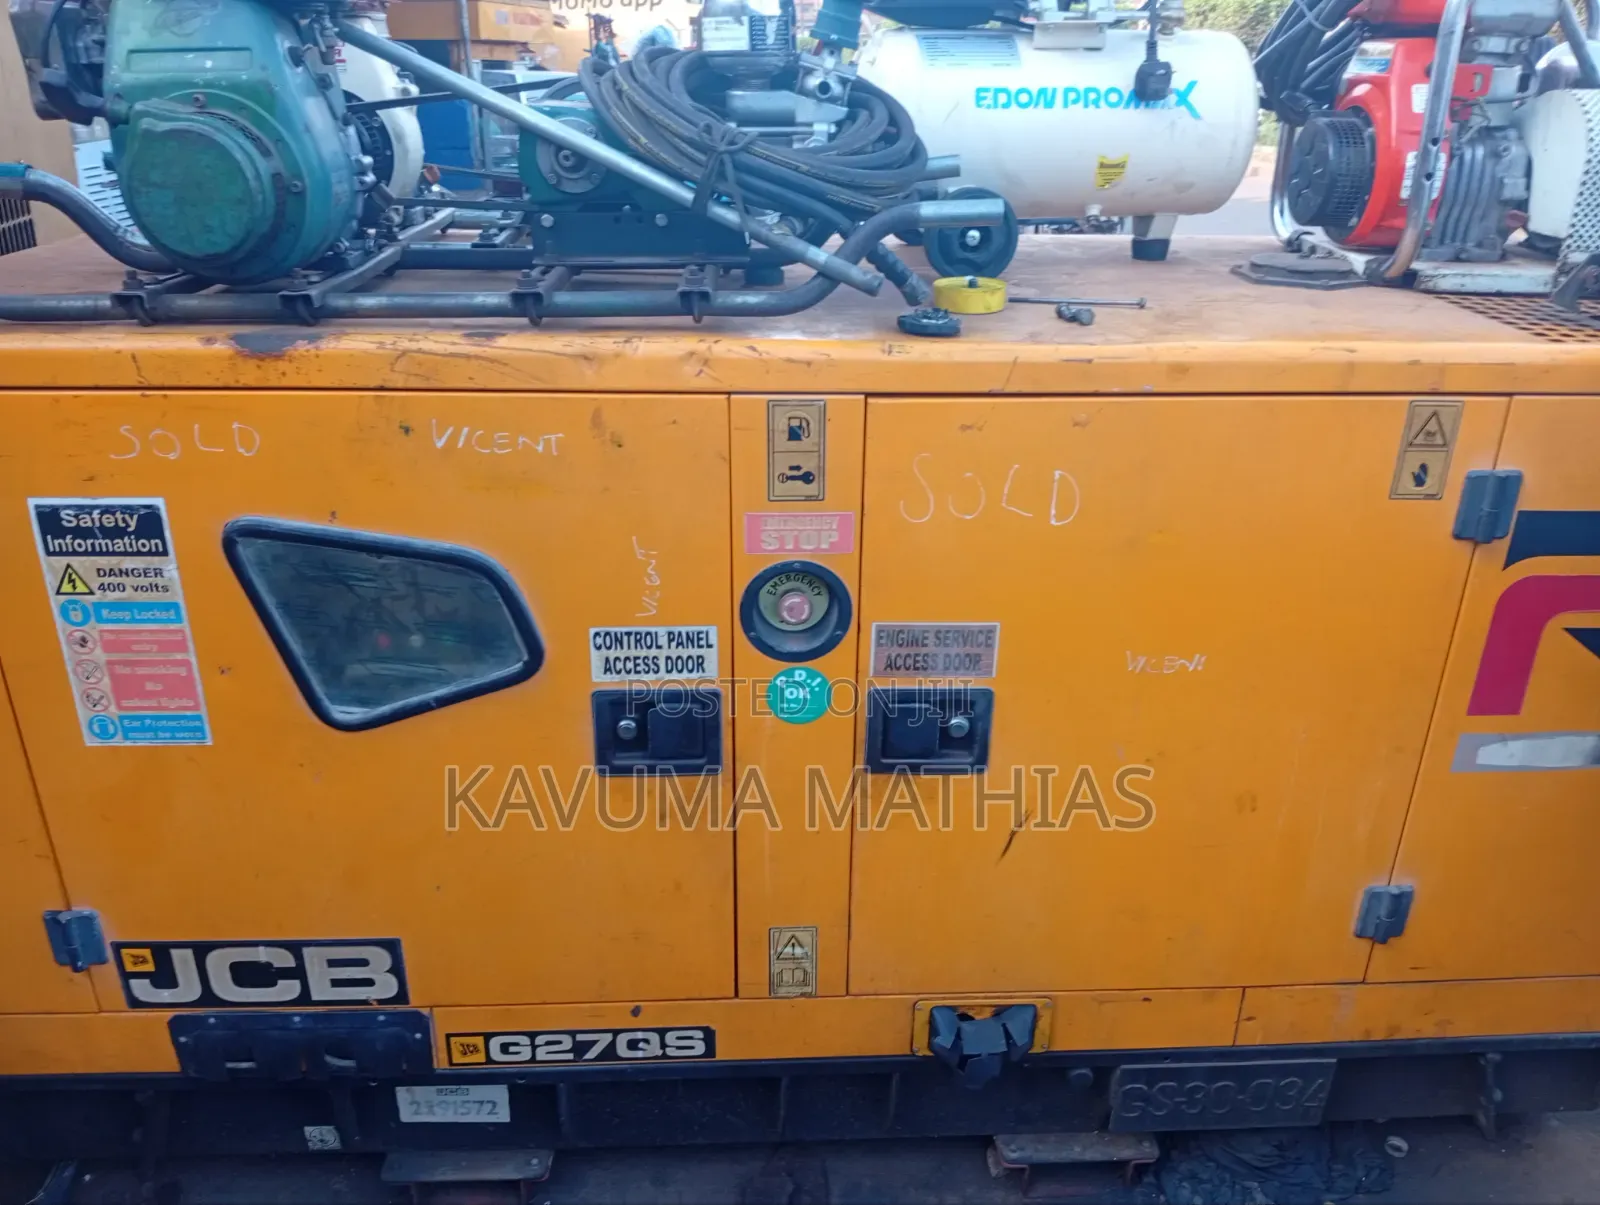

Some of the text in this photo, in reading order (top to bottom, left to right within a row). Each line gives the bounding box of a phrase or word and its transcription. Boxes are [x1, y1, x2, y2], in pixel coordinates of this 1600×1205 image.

[620, 0, 662, 11] app
[975, 87, 1057, 109] EDON
[109, 421, 260, 459] SOLD
[432, 418, 564, 456] VICENT
[899, 453, 1080, 526] SOLD
[60, 510, 138, 532] Safety
[46, 535, 163, 552] Information
[760, 530, 839, 550] STOP
[96, 567, 164, 578] DANGER
[97, 583, 170, 593] 400 volts
[766, 573, 823, 597] EMERGENCY
[101, 608, 176, 621] Keep Locked
[593, 630, 713, 650] CONTROL PANEL
[876, 629, 994, 648] ENGINE SERVICE
[603, 655, 705, 675] ACCESS DOOR
[884, 653, 982, 671] ACCESS DOOR
[785, 688, 811, 698] OK
[123, 719, 201, 727] Ear Protection
[129, 946, 399, 1003] JCB
[488, 1030, 706, 1062] G27QS
